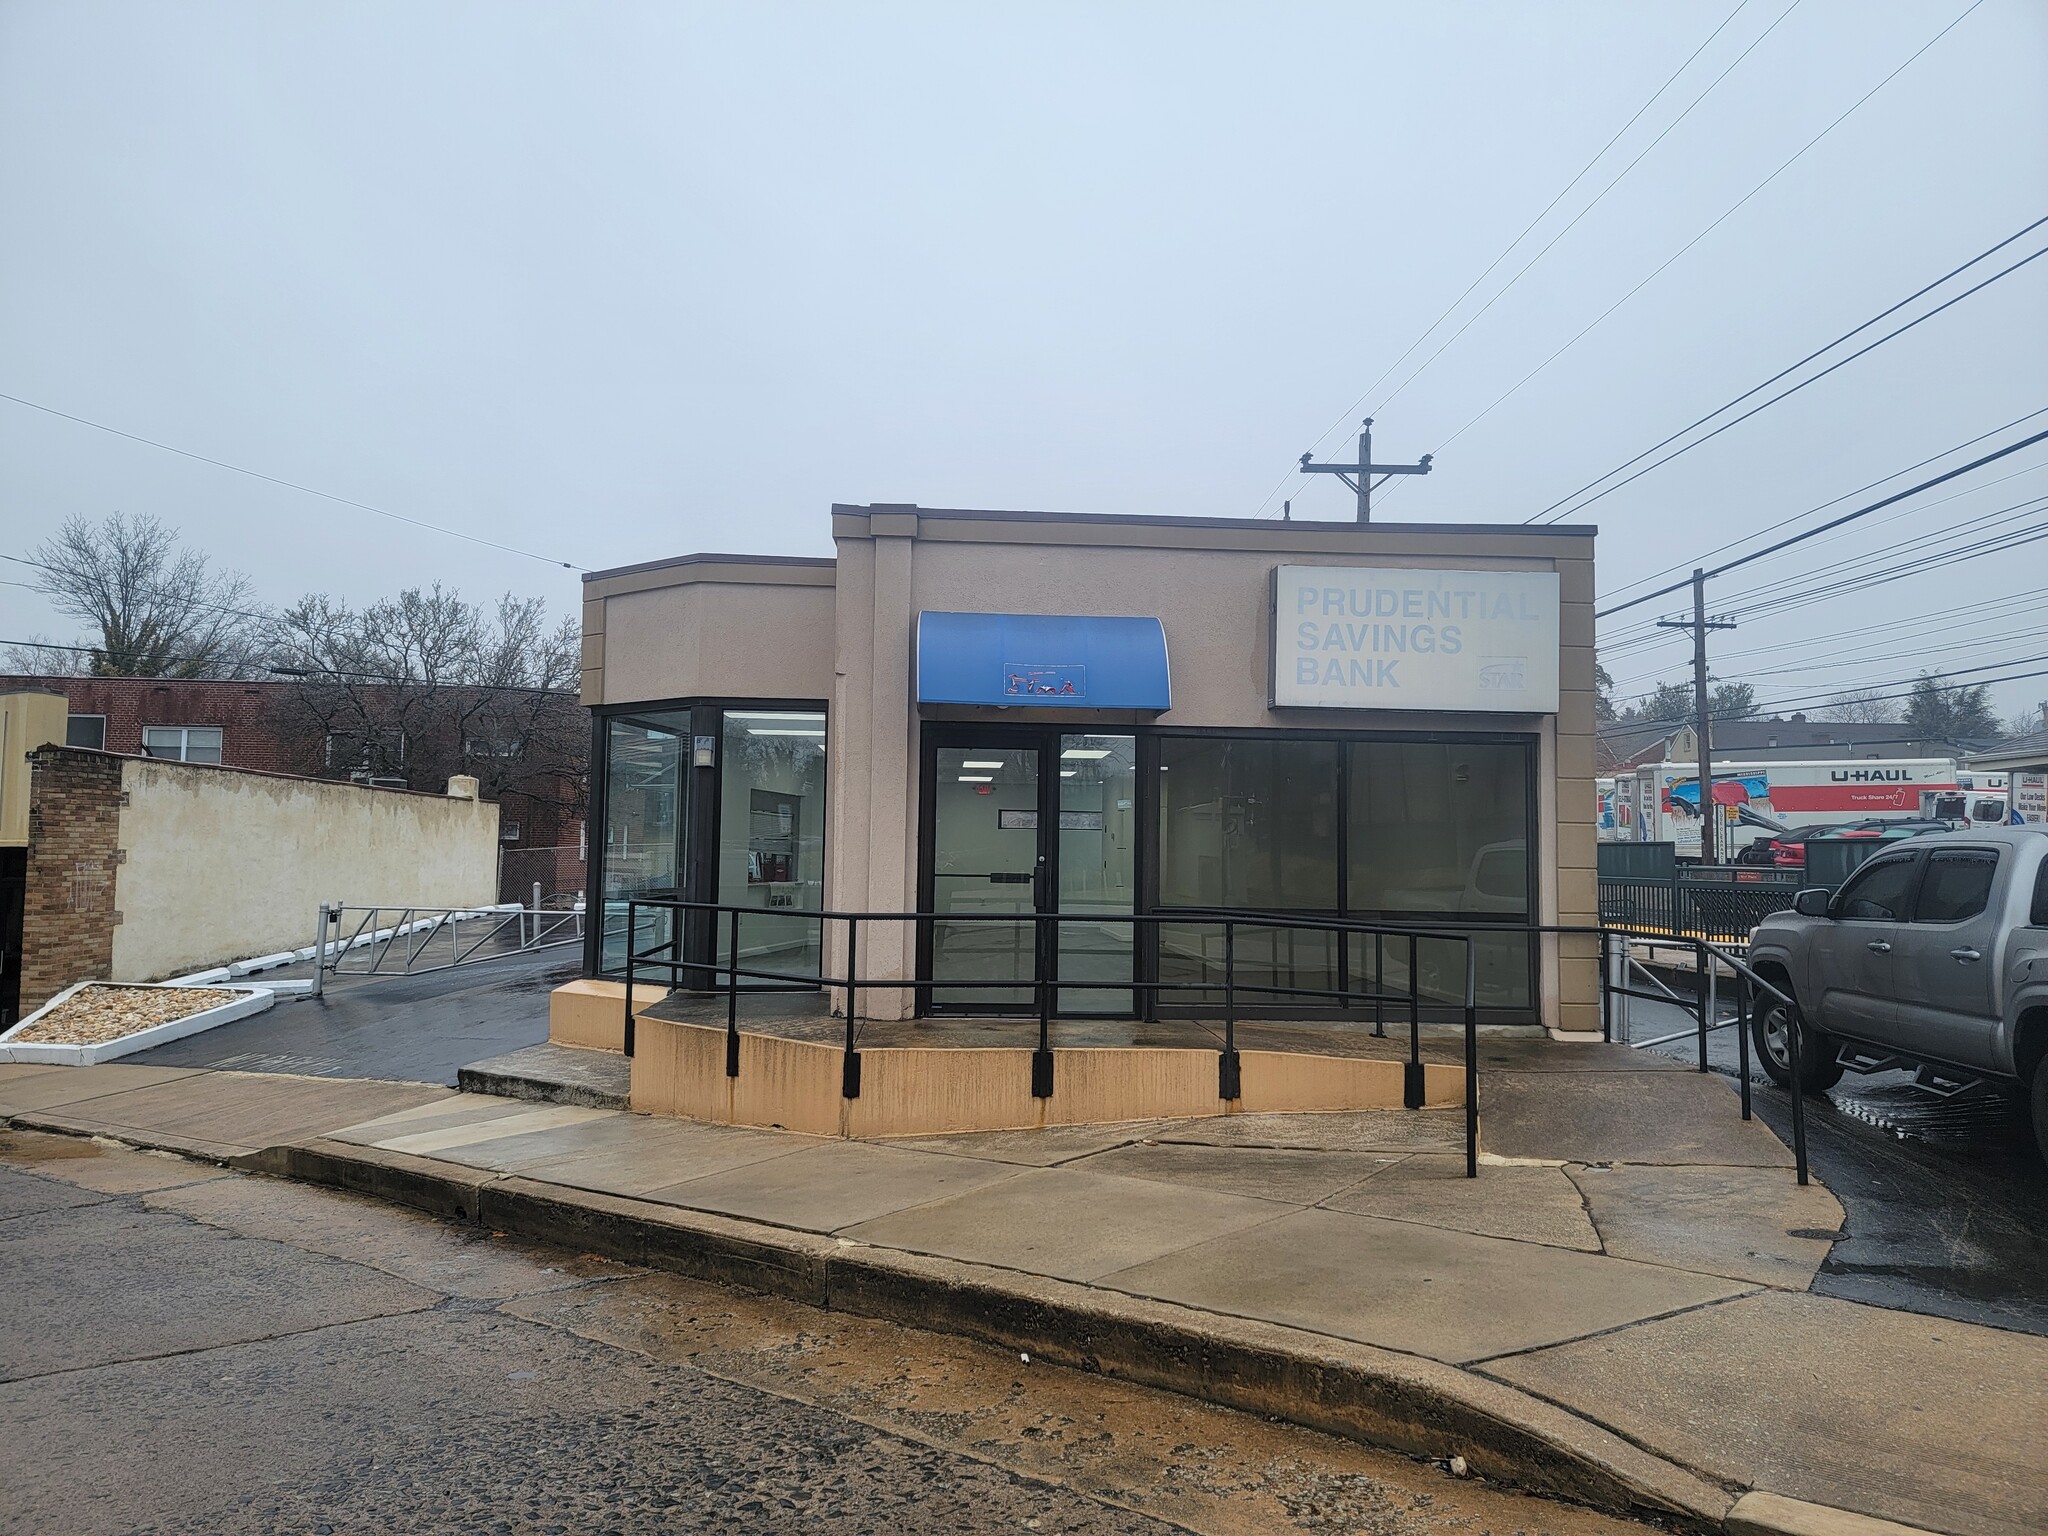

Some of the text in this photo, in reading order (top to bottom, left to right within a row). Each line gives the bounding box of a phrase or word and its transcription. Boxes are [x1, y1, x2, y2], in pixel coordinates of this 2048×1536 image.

[1296, 586, 1540, 622] PRUDENTIAL
[1296, 621, 1463, 655] SAVINGS
[1295, 656, 1401, 688] BANK
[1831, 769, 1913, 782] U-HAUL
